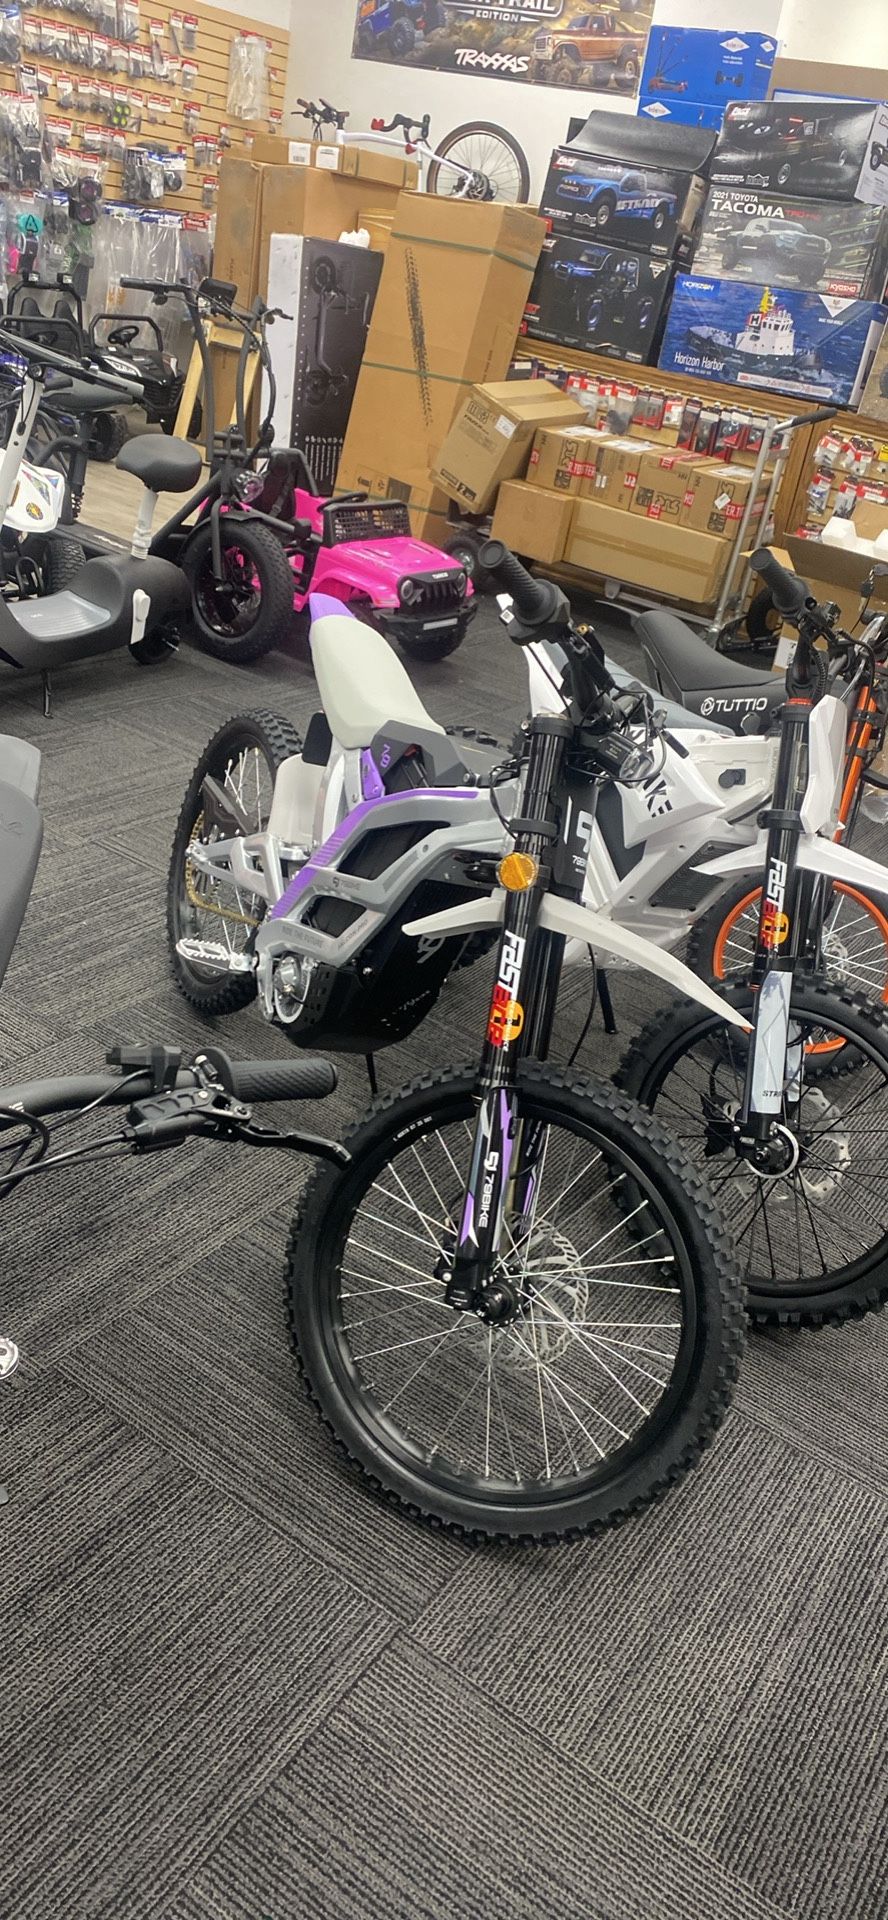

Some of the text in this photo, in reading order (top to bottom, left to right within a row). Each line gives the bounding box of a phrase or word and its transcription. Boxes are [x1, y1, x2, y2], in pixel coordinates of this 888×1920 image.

[475, 9, 520, 22] EDITION
[454, 48, 530, 73] TRAXXAS
[712, 191, 759, 203] 2021 TOYOTA
[711, 199, 785, 218] TACOMA
[674, 352, 701, 367] Horizon
[702, 357, 725, 372] Harbor
[715, 697, 767, 711] TUTTIO
